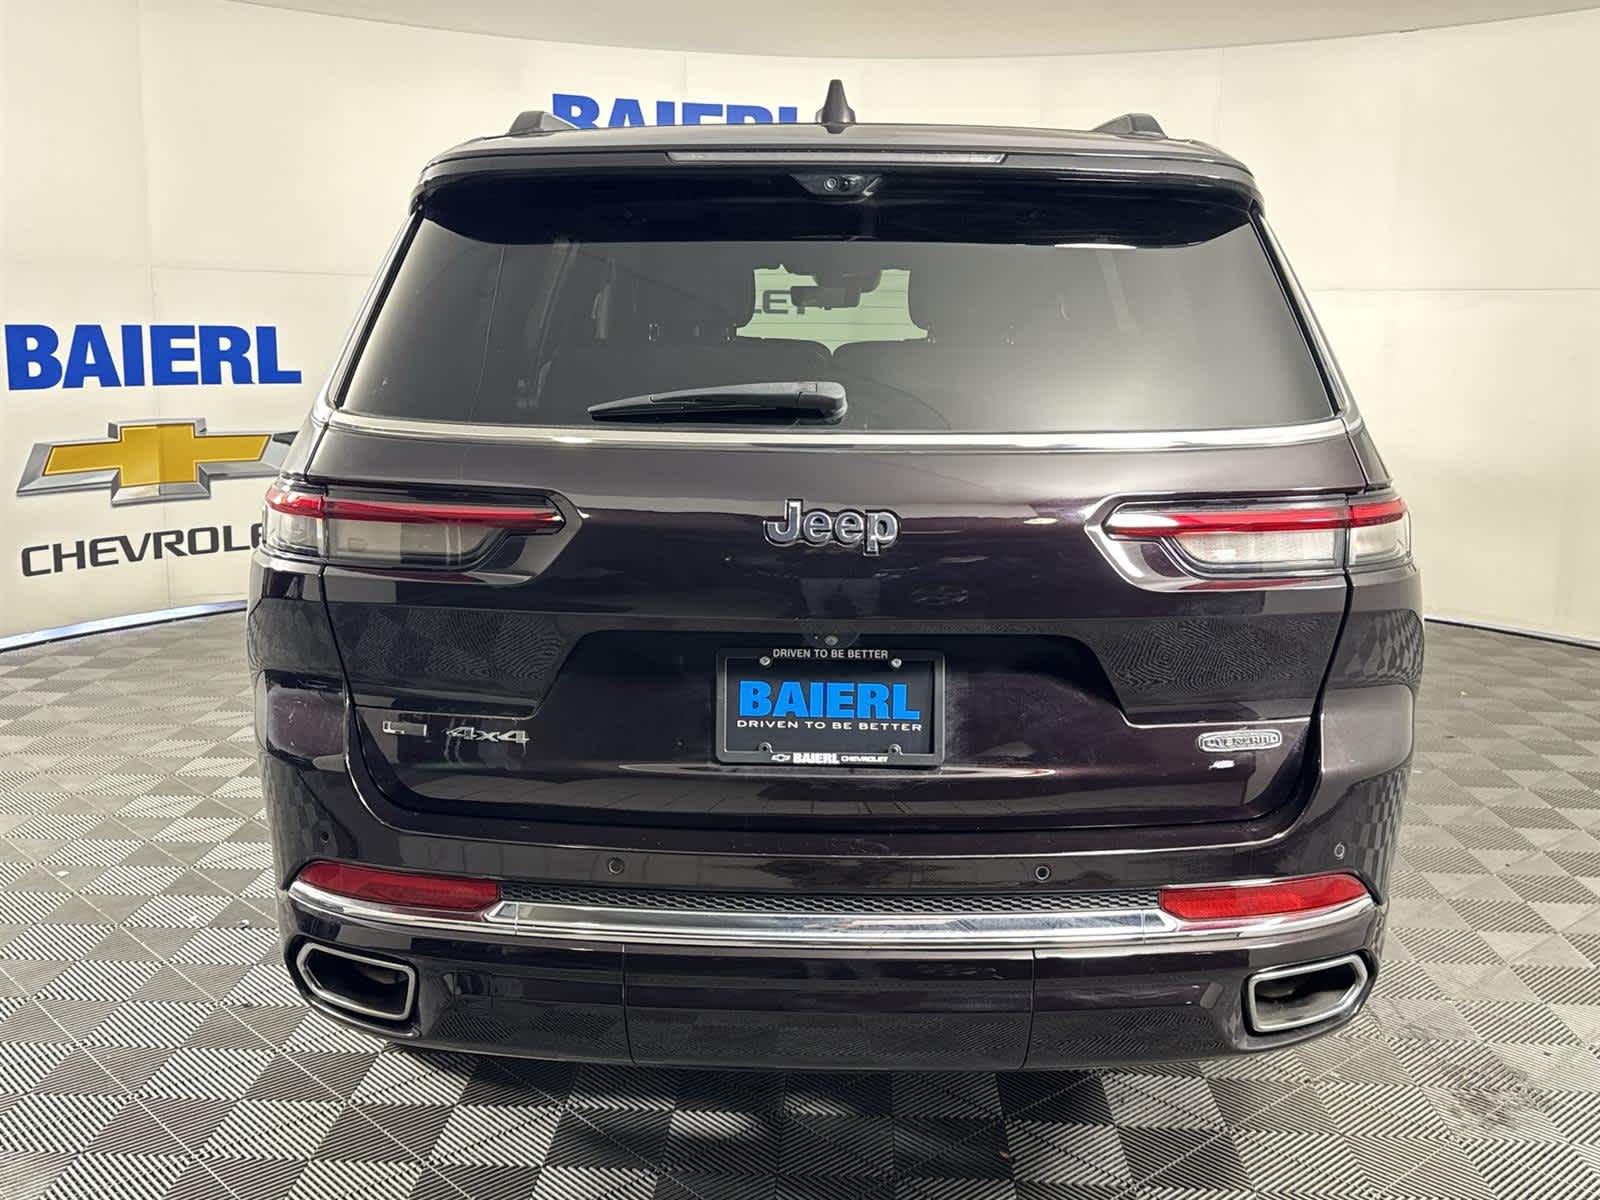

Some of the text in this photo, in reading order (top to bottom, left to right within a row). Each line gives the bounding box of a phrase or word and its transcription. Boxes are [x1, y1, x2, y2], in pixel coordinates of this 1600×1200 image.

[4, 324, 302, 391] BAIERL
[763, 498, 901, 556] Jeep
[773, 648, 888, 659] DRIVEN TO BE BETTER
[738, 680, 921, 720] BAIERL
[737, 720, 922, 731] DRIVEN TO BE BETTER
[445, 726, 530, 743] 4x4
[793, 753, 889, 764] BAIERL CHEVROLET
